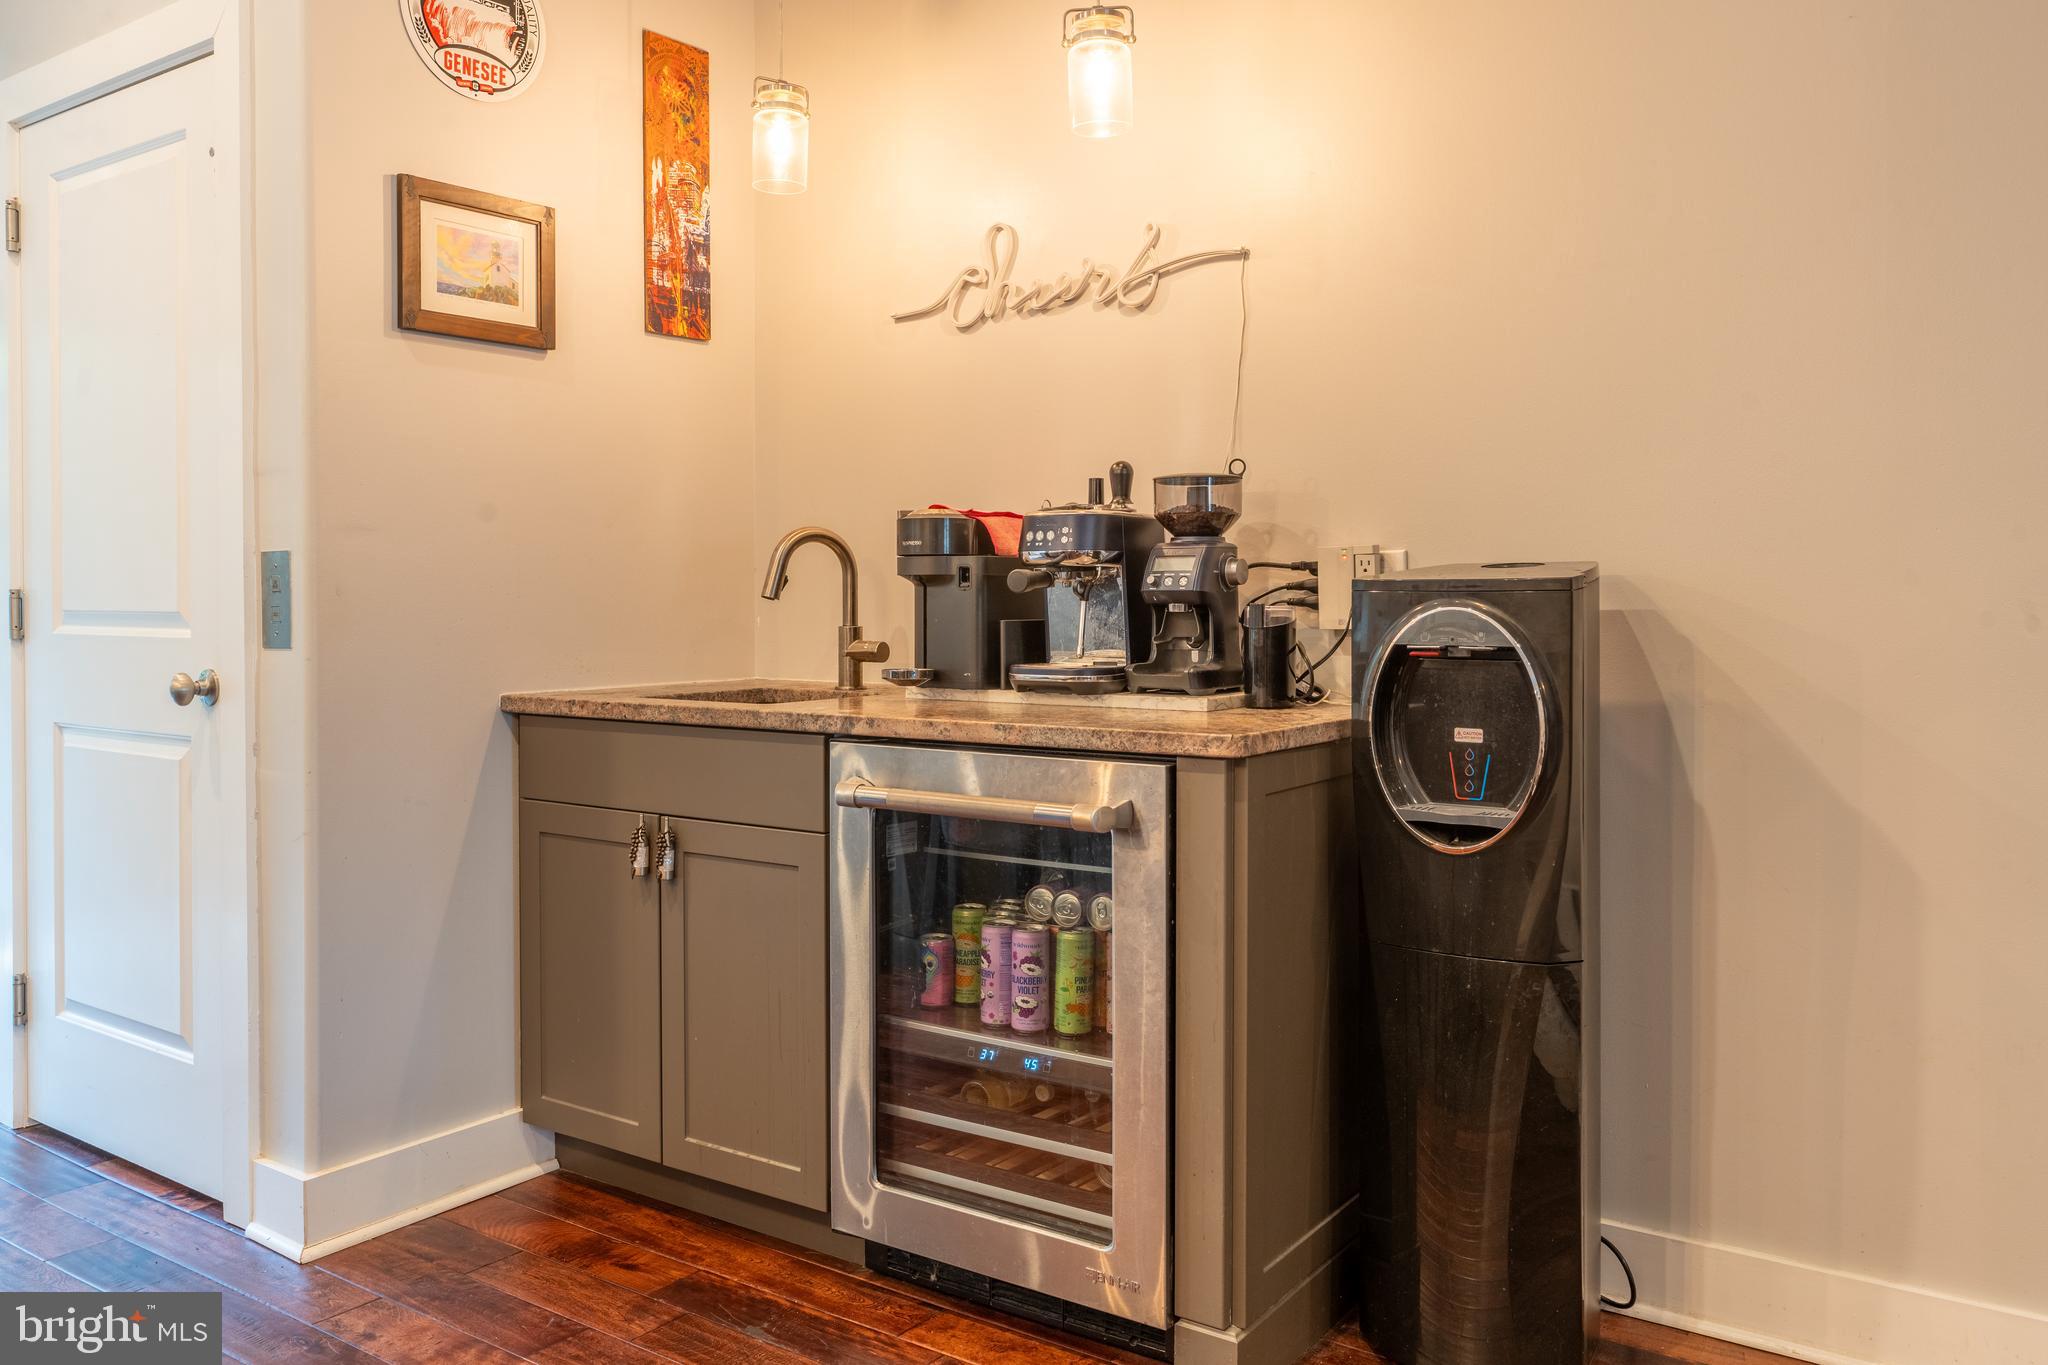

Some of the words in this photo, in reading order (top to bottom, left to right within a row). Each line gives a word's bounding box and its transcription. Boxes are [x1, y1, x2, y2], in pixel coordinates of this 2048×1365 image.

[443, 50, 507, 86] GENESEE
[1017, 985, 1040, 994] VIOLET
[980, 1048, 995, 1061] 37
[1024, 1058, 1038, 1070] 45
